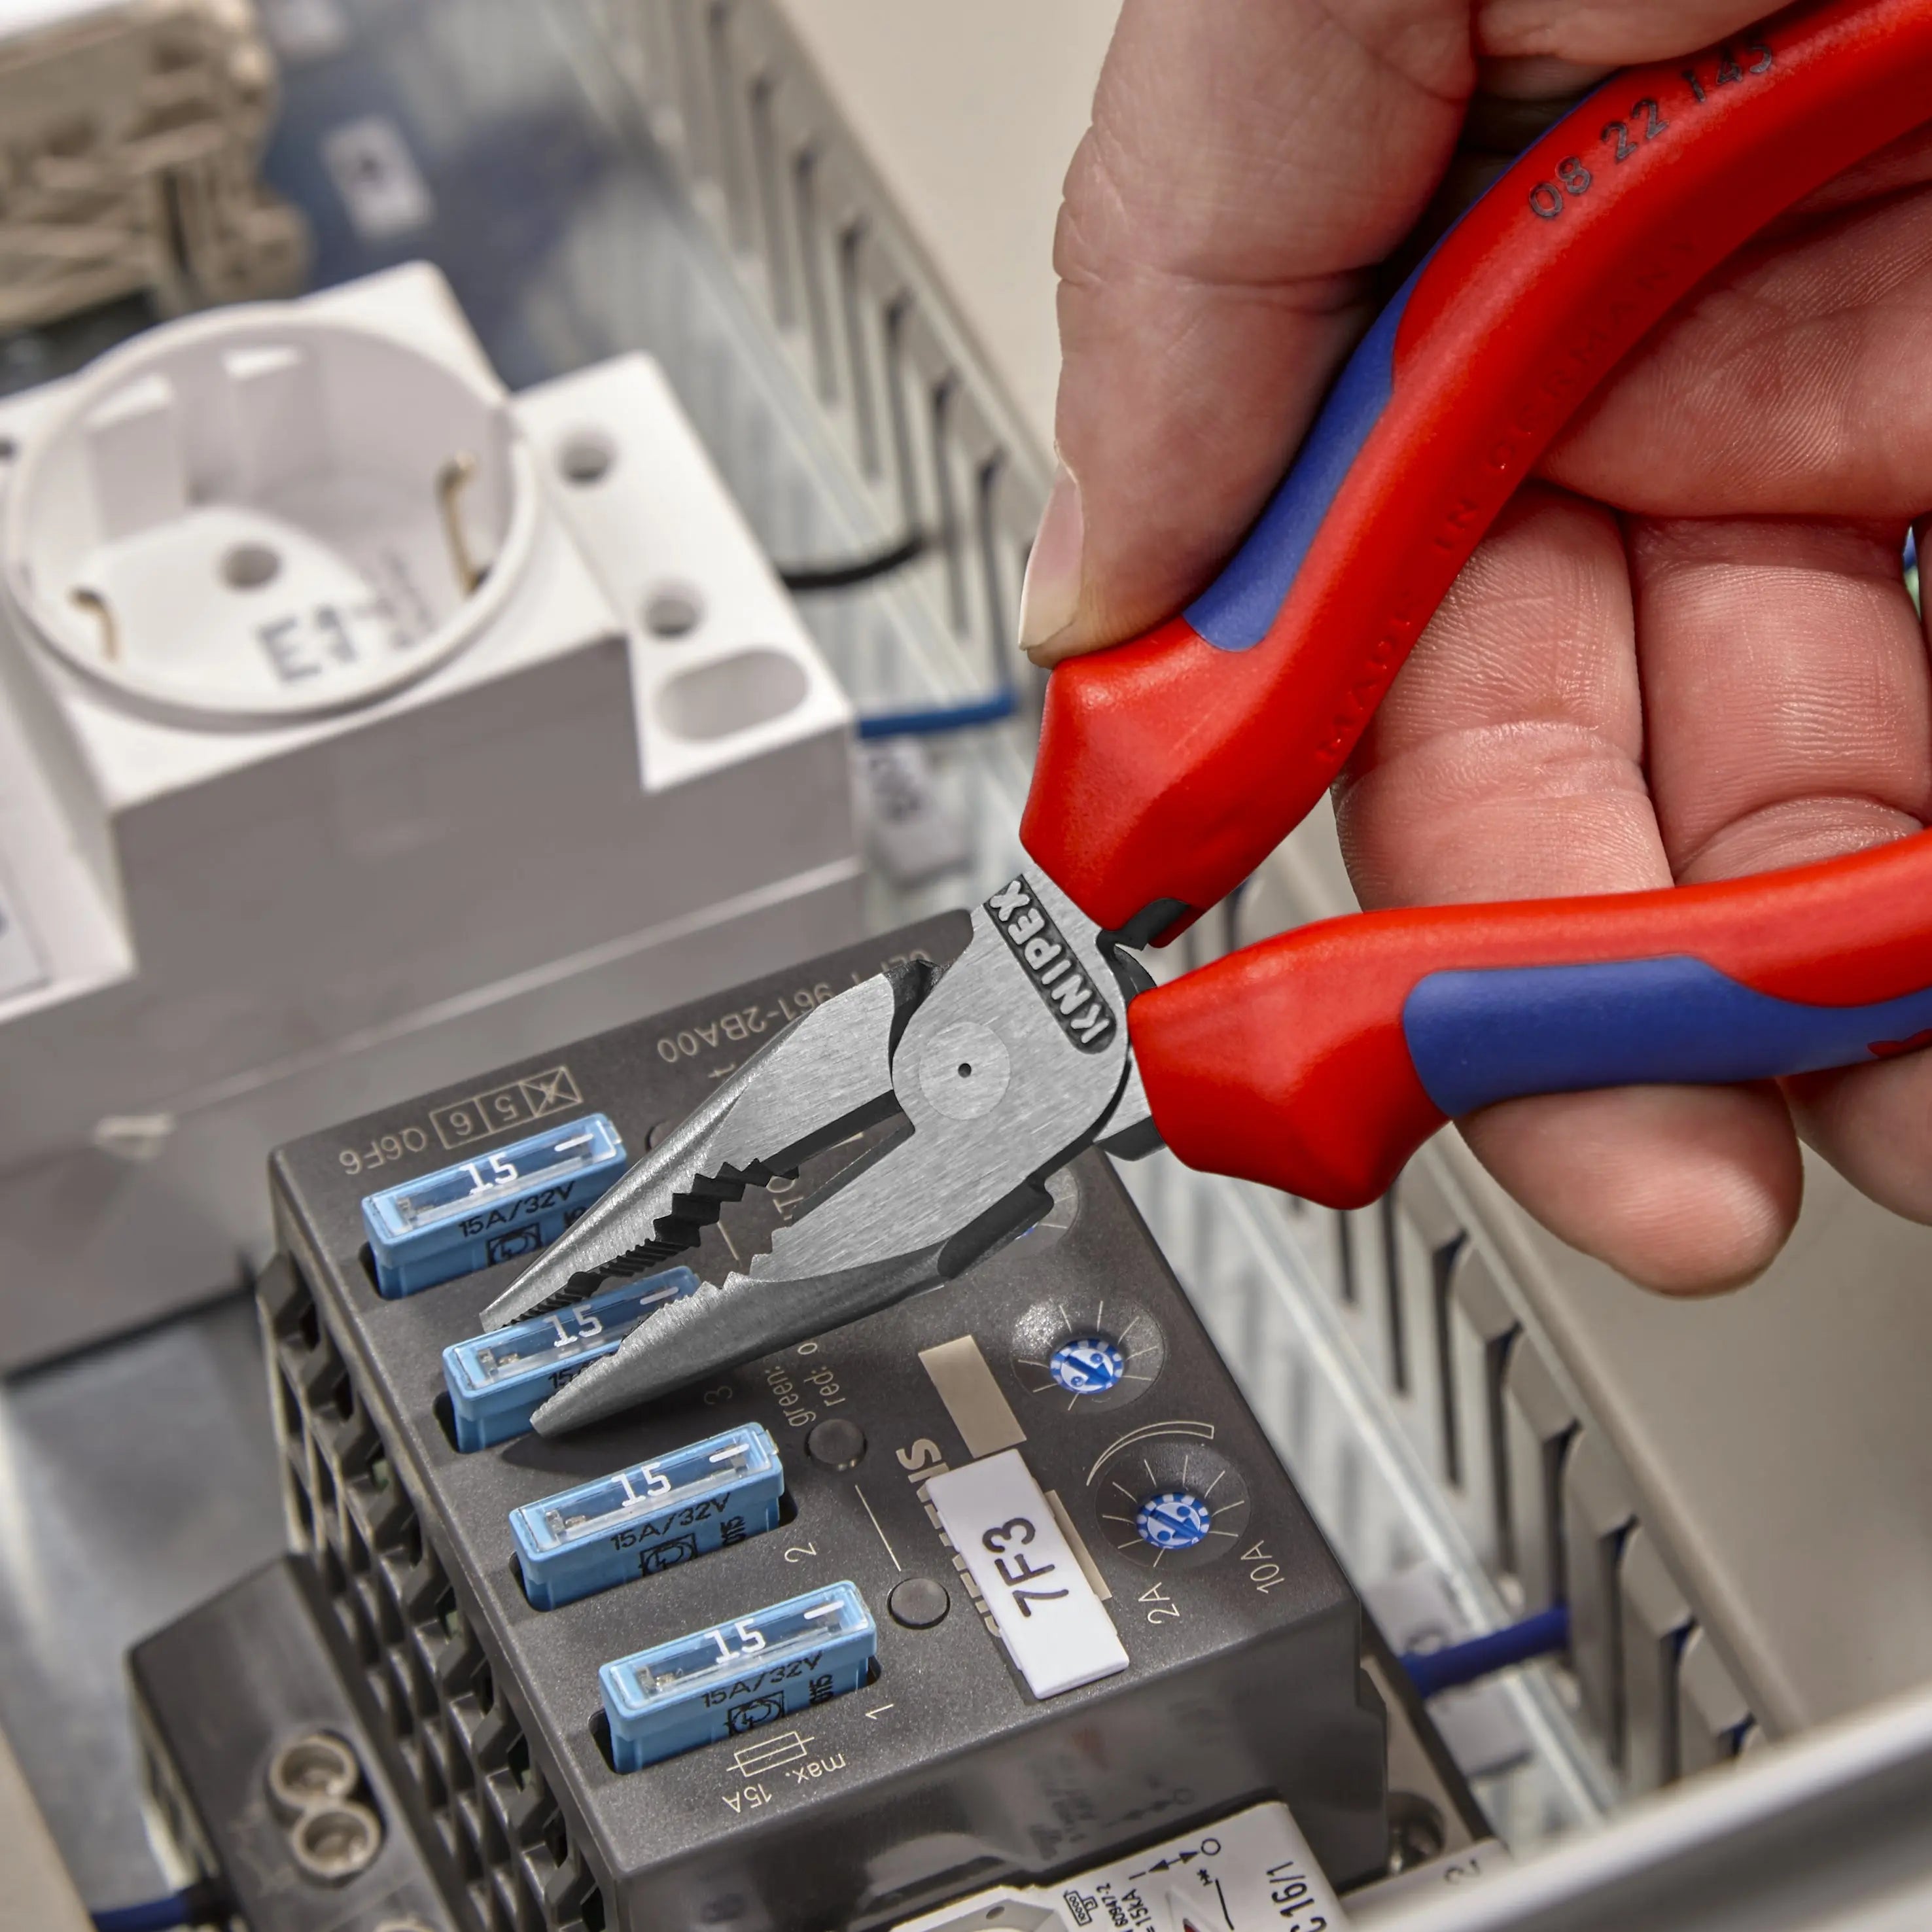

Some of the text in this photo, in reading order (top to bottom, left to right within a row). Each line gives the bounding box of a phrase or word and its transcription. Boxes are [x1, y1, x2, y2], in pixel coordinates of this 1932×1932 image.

[1529, 156, 1592, 218] 08
[1601, 99, 1670, 162] 22
[1434, 497, 1481, 551] IN
[989, 880, 1110, 1044] KNIPEX
[449, 1112, 472, 1136] 6
[338, 1126, 429, 1175] Q6F6
[459, 1152, 518, 1196] 15
[458, 1180, 576, 1238] 15A/32V
[542, 1304, 603, 1348] 15
[703, 1385, 733, 1405] 3
[764, 1365, 817, 1428] green:
[803, 1365, 847, 1407] red:
[611, 1462, 672, 1507] 15
[610, 1492, 731, 1551] 15A/32V
[784, 1541, 817, 1564] 2
[981, 1517, 1070, 1618] 7F3
[1240, 1539, 1286, 1594] 10A
[1138, 1581, 1180, 1625] 2A
[704, 1617, 767, 1664] 15
[700, 1651, 824, 1709] 15A/32V
[865, 1703, 894, 1720] 1
[722, 1753, 847, 1814] max. 15A
[1121, 1888, 1152, 1927] 15kA
[1266, 1861, 1315, 1918] 16/1
